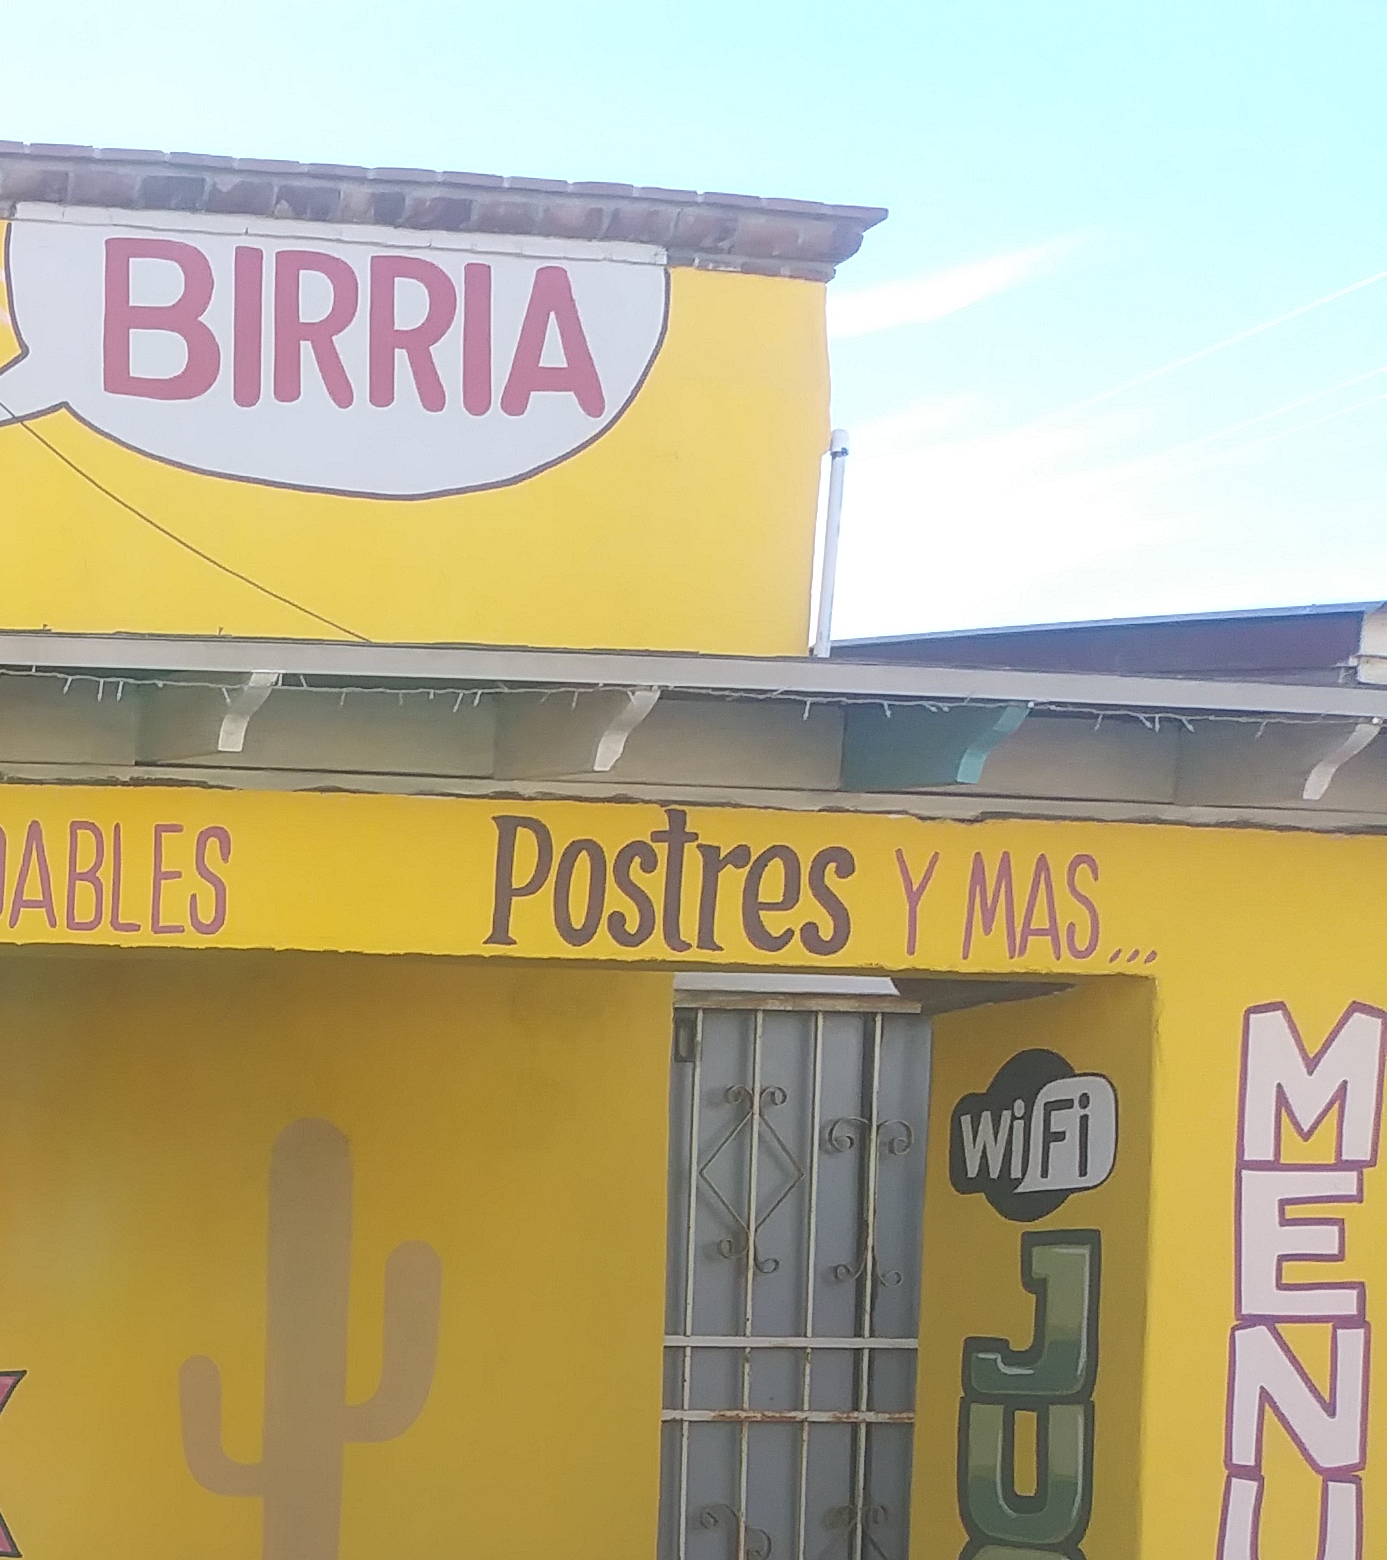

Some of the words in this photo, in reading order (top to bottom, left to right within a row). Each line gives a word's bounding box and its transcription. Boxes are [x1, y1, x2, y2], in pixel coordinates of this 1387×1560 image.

[99, 236, 607, 420] BIRRIA
[482, 808, 857, 957] Postres
[894, 846, 940, 957] Y
